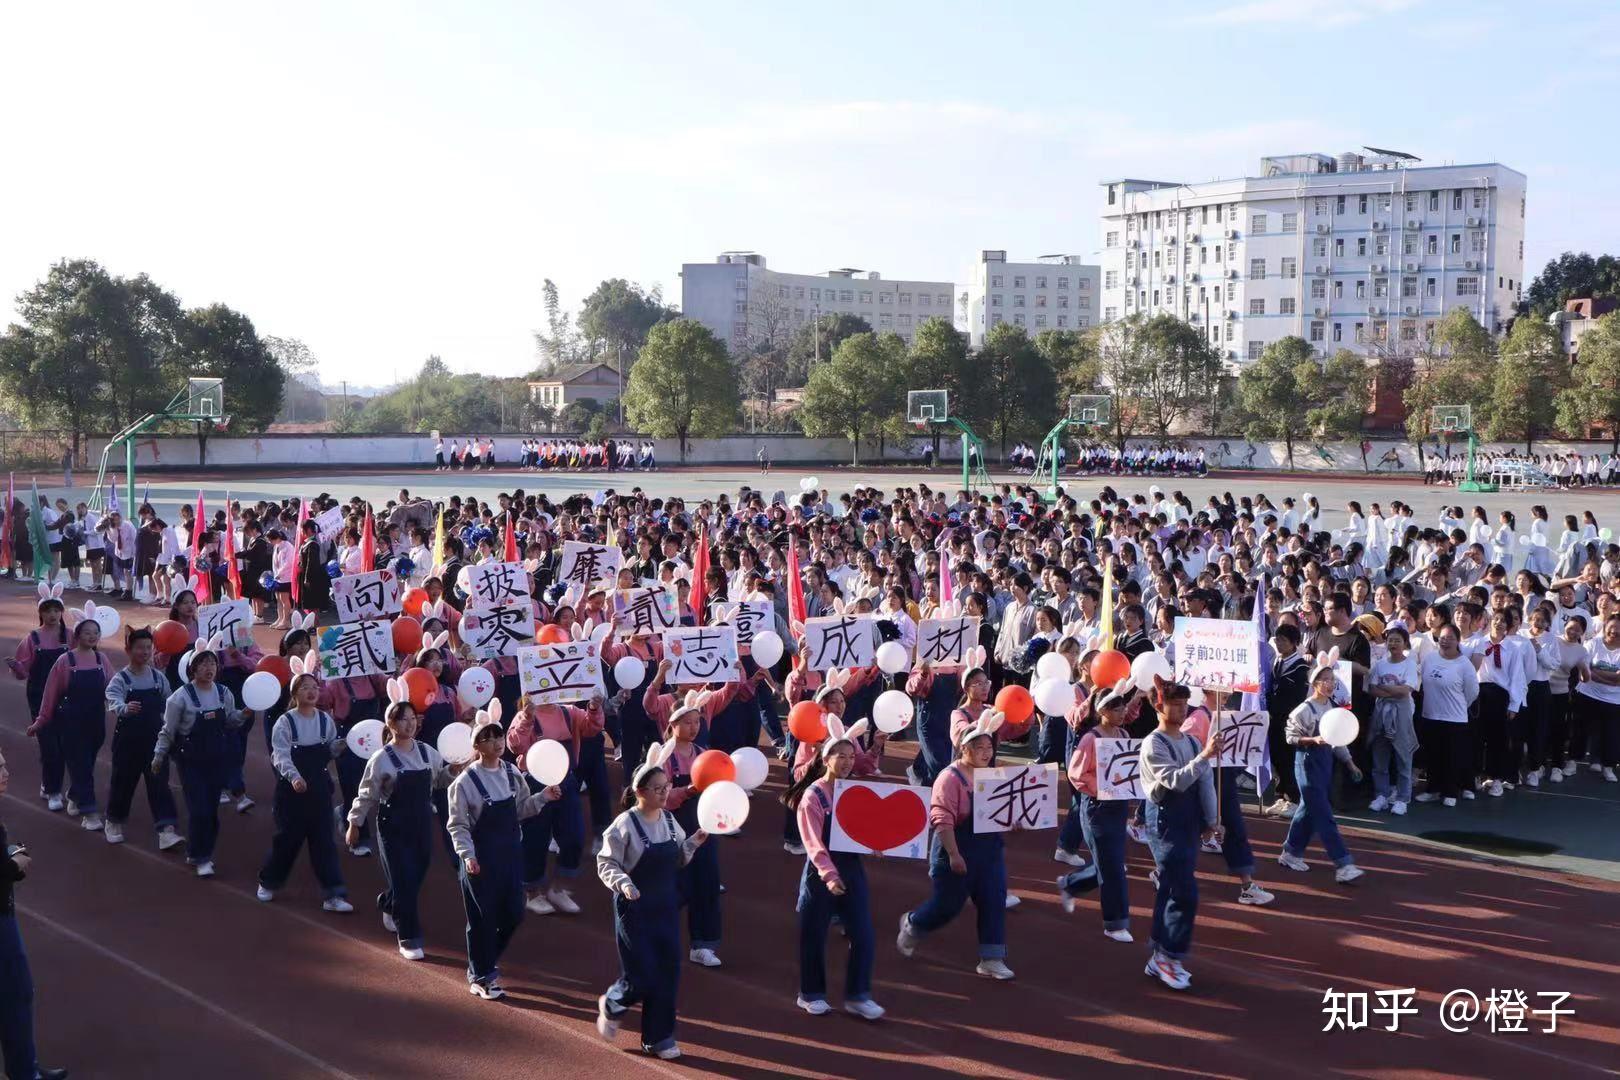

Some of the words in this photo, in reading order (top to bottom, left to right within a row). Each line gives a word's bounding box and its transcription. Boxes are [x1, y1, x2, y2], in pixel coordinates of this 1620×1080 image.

[479, 565, 528, 602] 披
[565, 547, 607, 584] 靡
[344, 579, 384, 612] 向
[207, 606, 242, 649] 所
[475, 606, 534, 655] 零
[815, 617, 862, 668] 成
[923, 619, 970, 663] 材
[527, 647, 597, 695] 立
[675, 629, 729, 677] 志
[1184, 643, 1248, 664] 学前2021班
[1220, 712, 1264, 765] 前
[1105, 740, 1141, 796] 学
[986, 767, 1049, 827] 我
